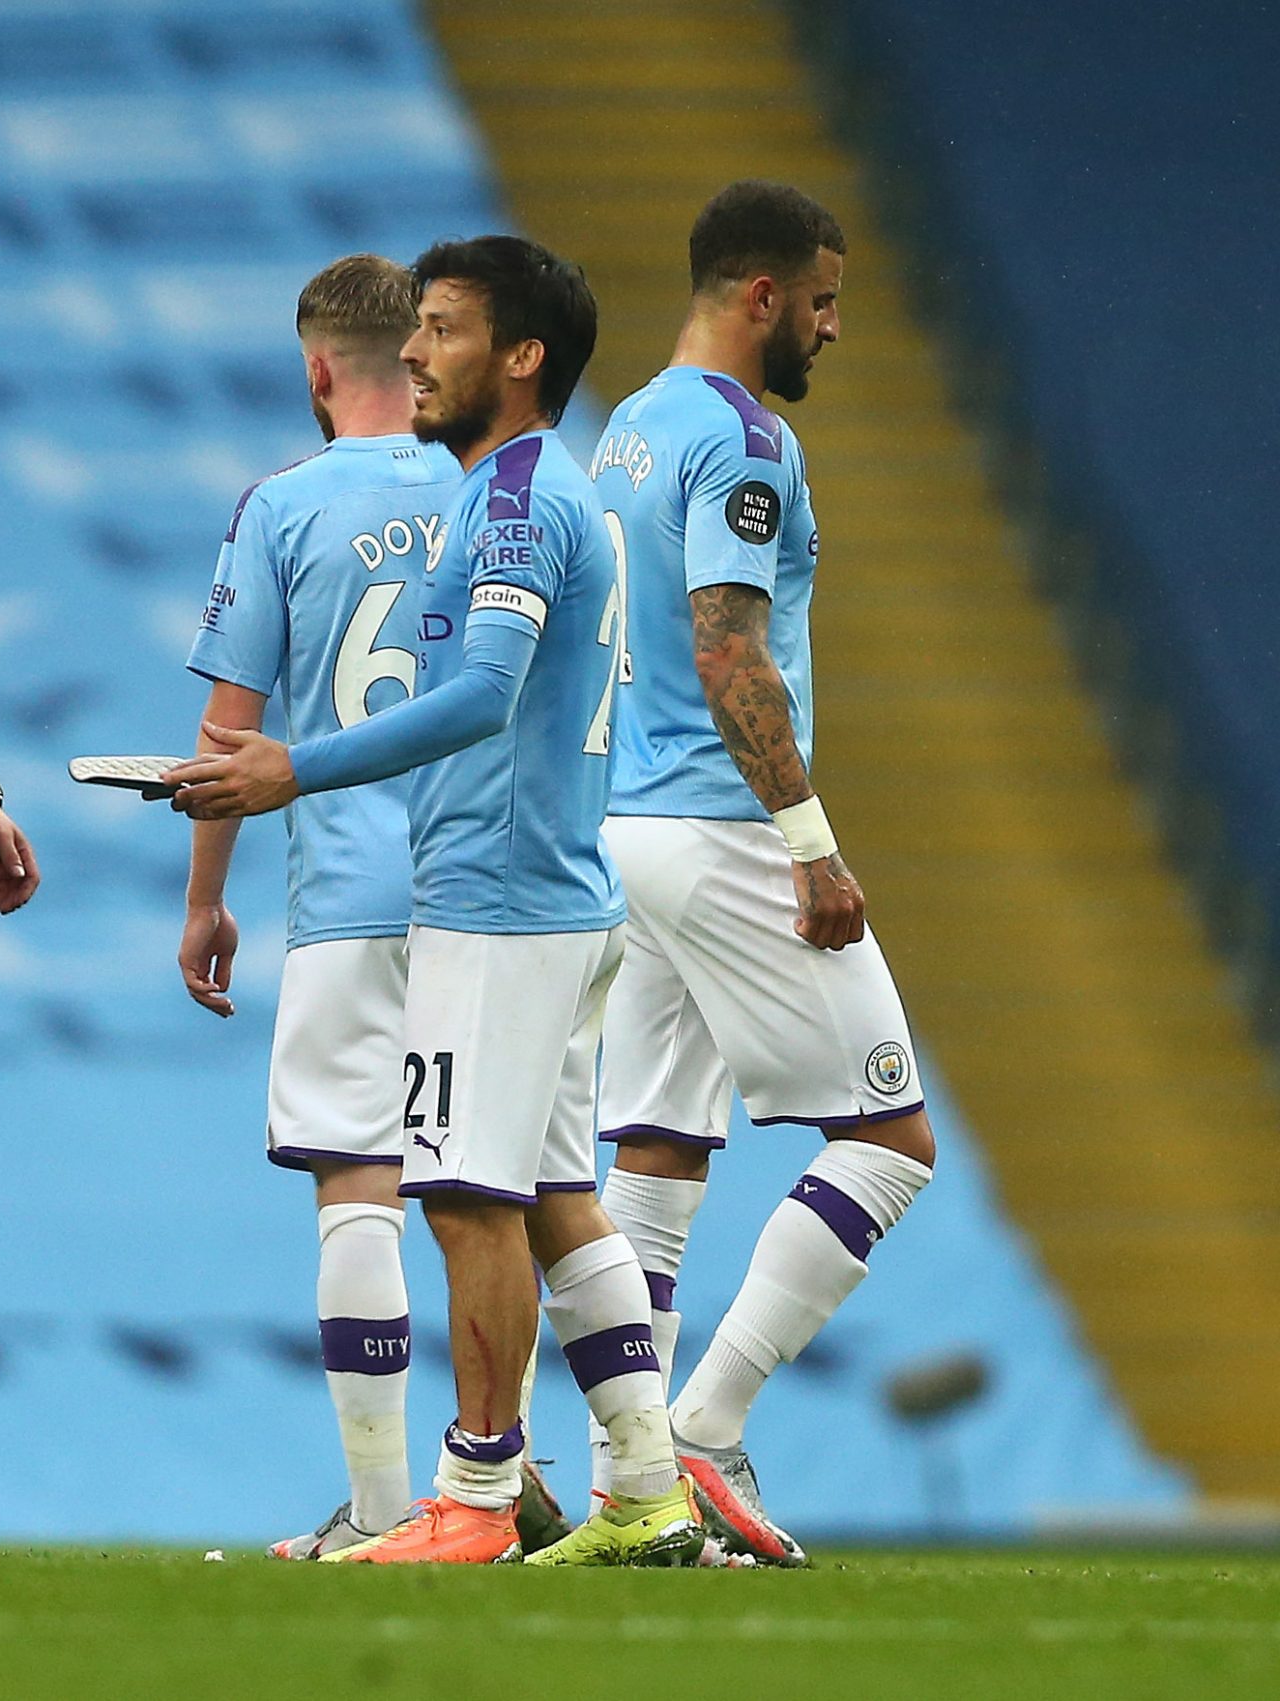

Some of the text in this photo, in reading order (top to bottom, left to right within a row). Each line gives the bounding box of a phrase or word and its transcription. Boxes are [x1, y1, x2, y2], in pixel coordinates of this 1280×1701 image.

[743, 505, 767, 521] LIVES
[738, 517, 768, 535] MATTER
[349, 513, 441, 573] DOY
[469, 523, 544, 556] NEXEN
[480, 546, 531, 570] TIRE
[472, 588, 523, 606] ptain
[332, 580, 417, 730] 6
[403, 1051, 453, 1129] 21
[363, 1335, 409, 1357] CITY
